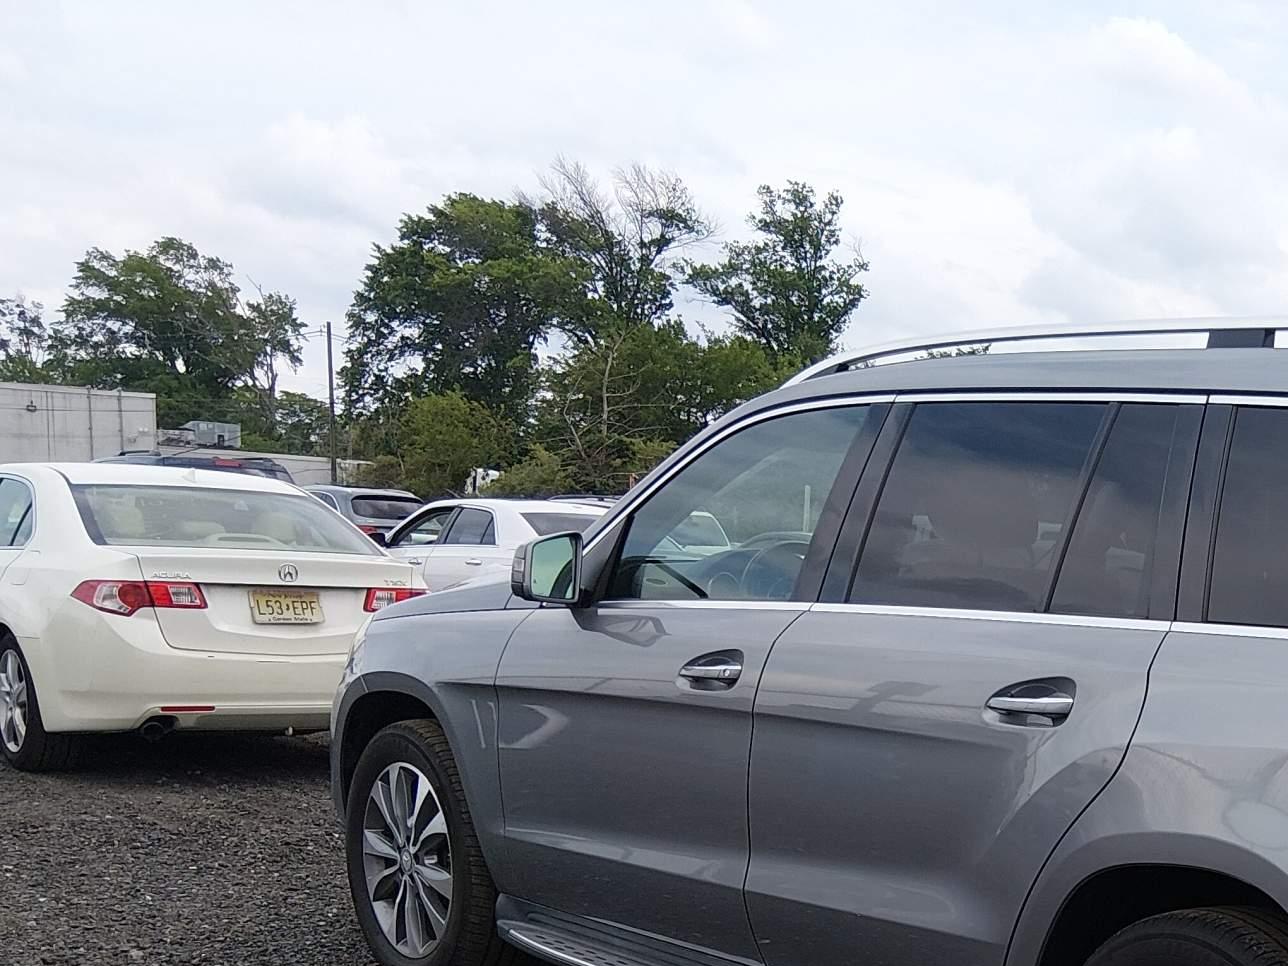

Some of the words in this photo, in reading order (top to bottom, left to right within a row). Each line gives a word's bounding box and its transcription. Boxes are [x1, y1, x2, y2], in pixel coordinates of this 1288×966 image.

[151, 571, 192, 579] ACURA
[256, 599, 284, 615] L53
[291, 600, 317, 616] EPF
